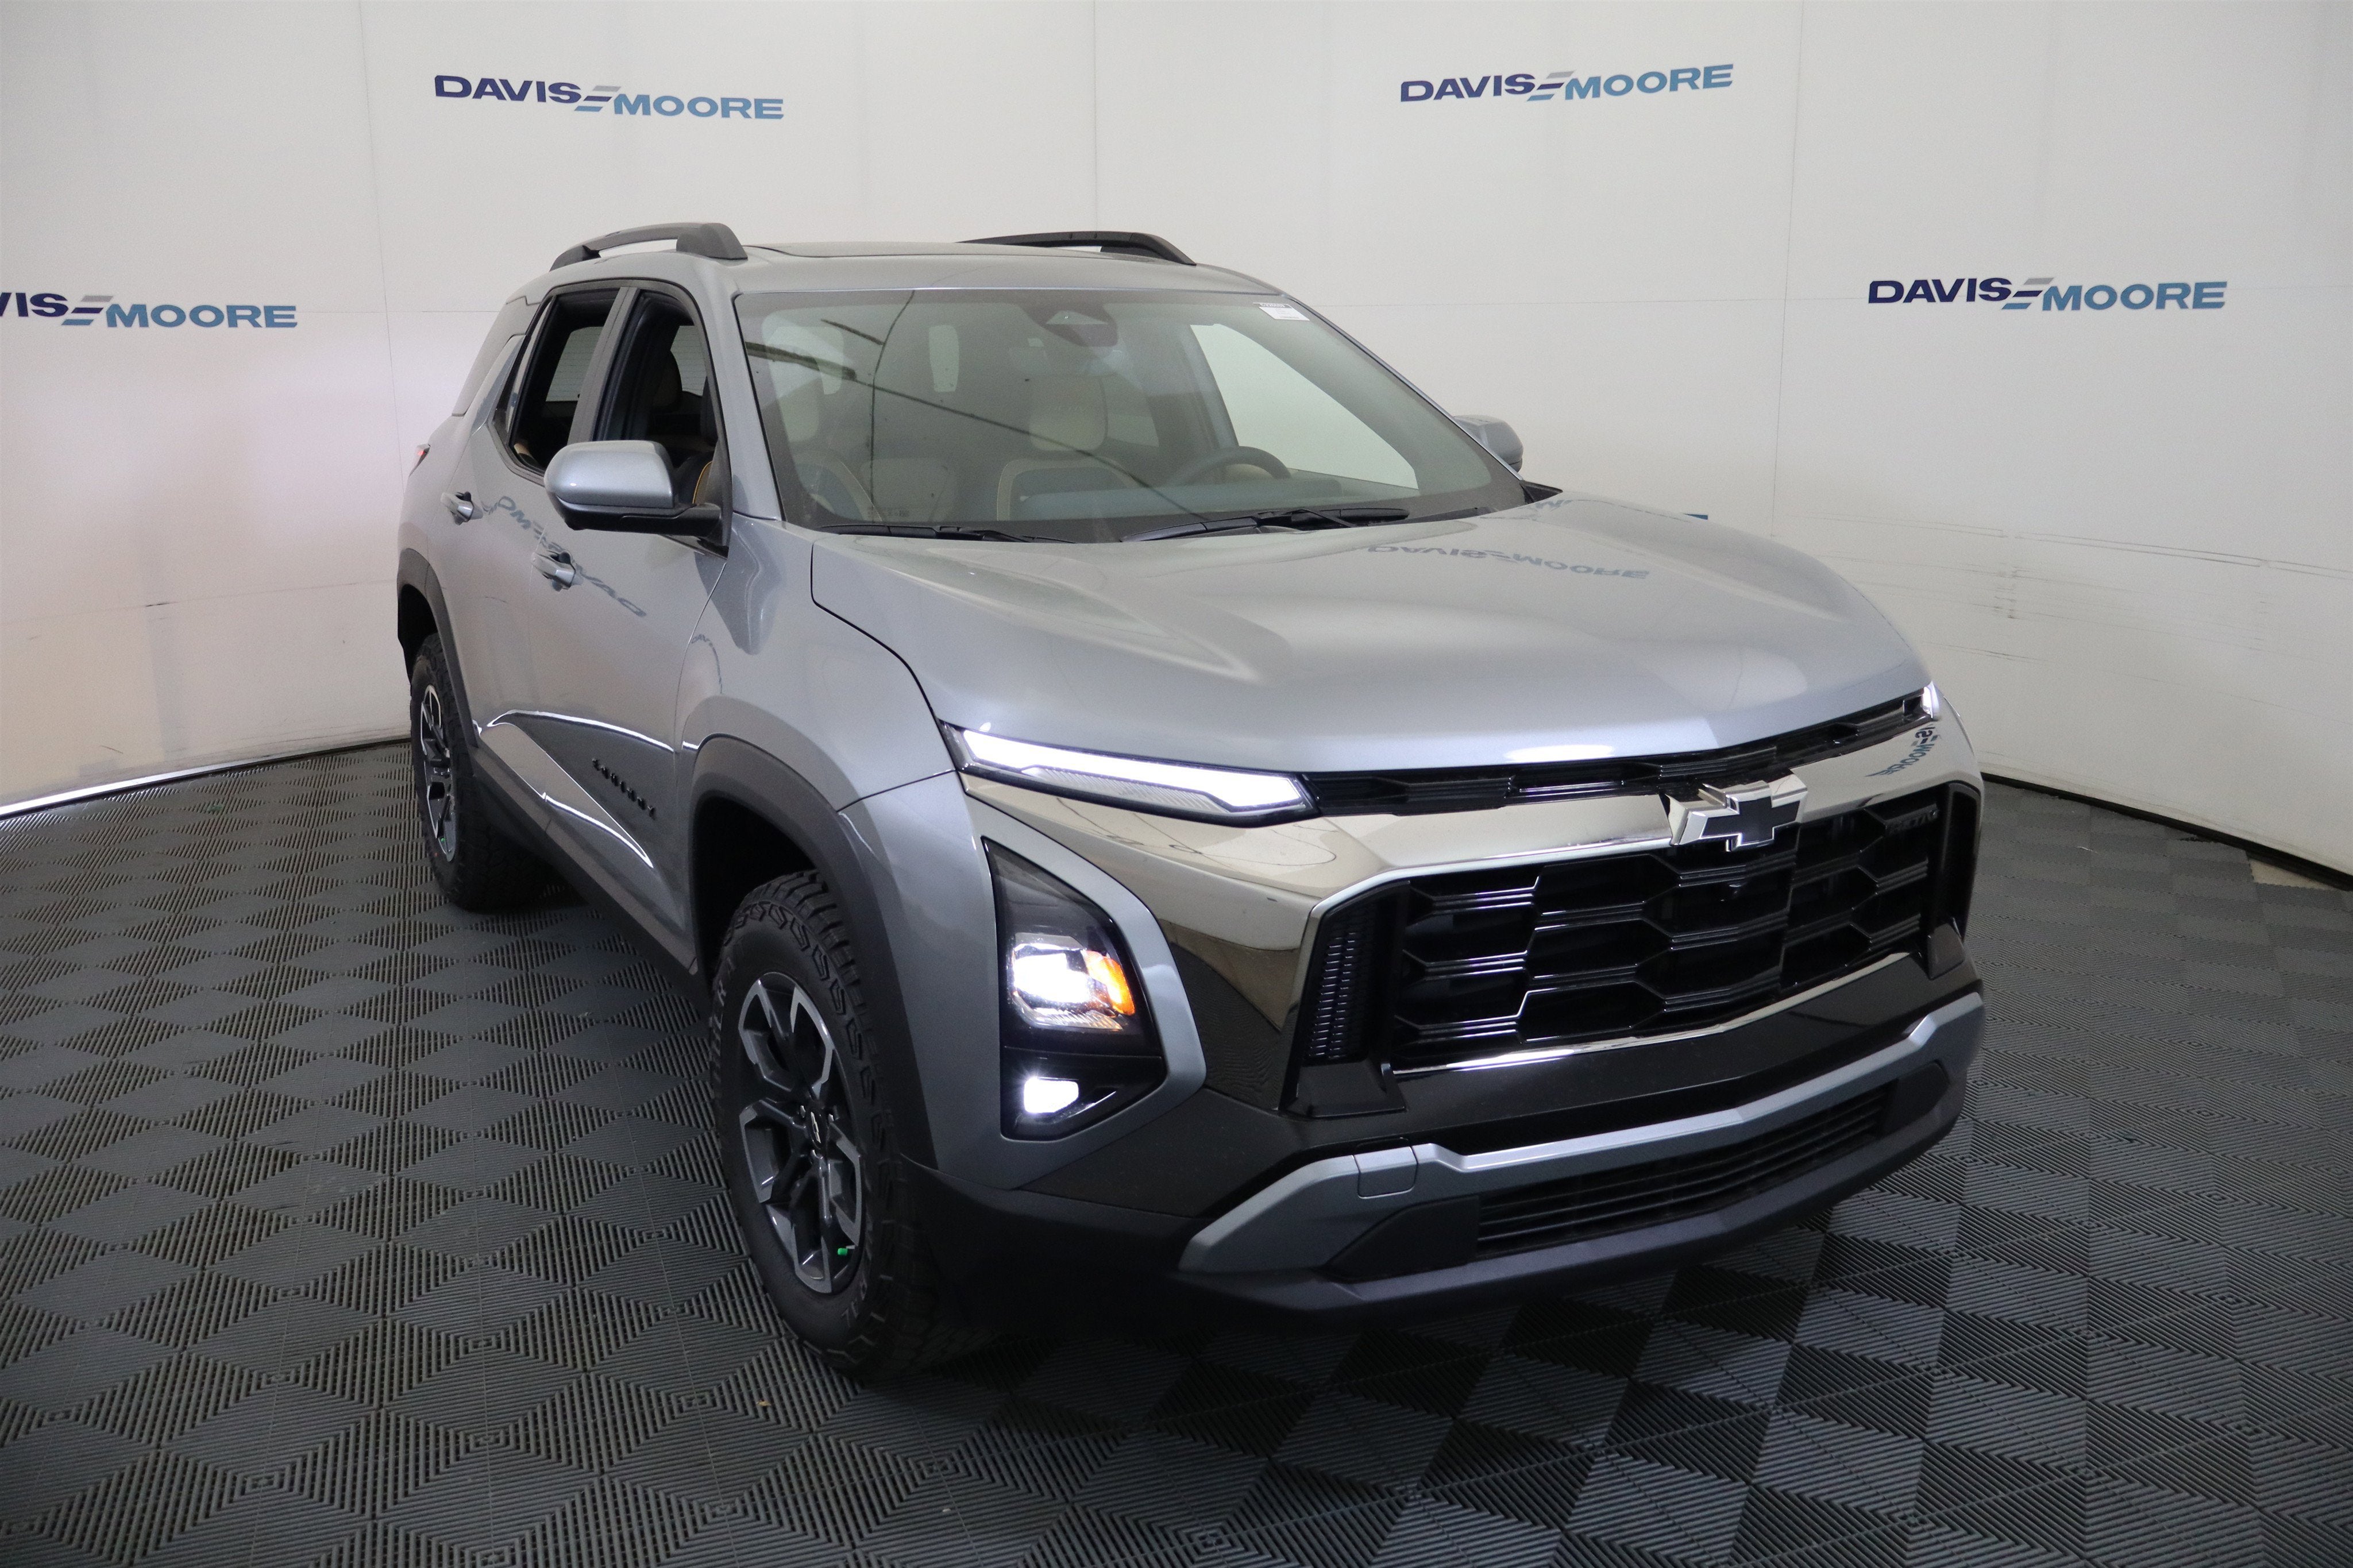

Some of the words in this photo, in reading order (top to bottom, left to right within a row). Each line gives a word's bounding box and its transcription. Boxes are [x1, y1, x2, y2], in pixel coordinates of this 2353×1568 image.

[434, 74, 582, 104] DAVIS
[613, 93, 784, 120] MOORE
[1400, 73, 1536, 103] DAVIS
[1565, 64, 1734, 101] MOORE
[1868, 277, 2012, 304] DAVIS
[2042, 281, 2228, 311] MOORE
[105, 303, 298, 328] MOORE
